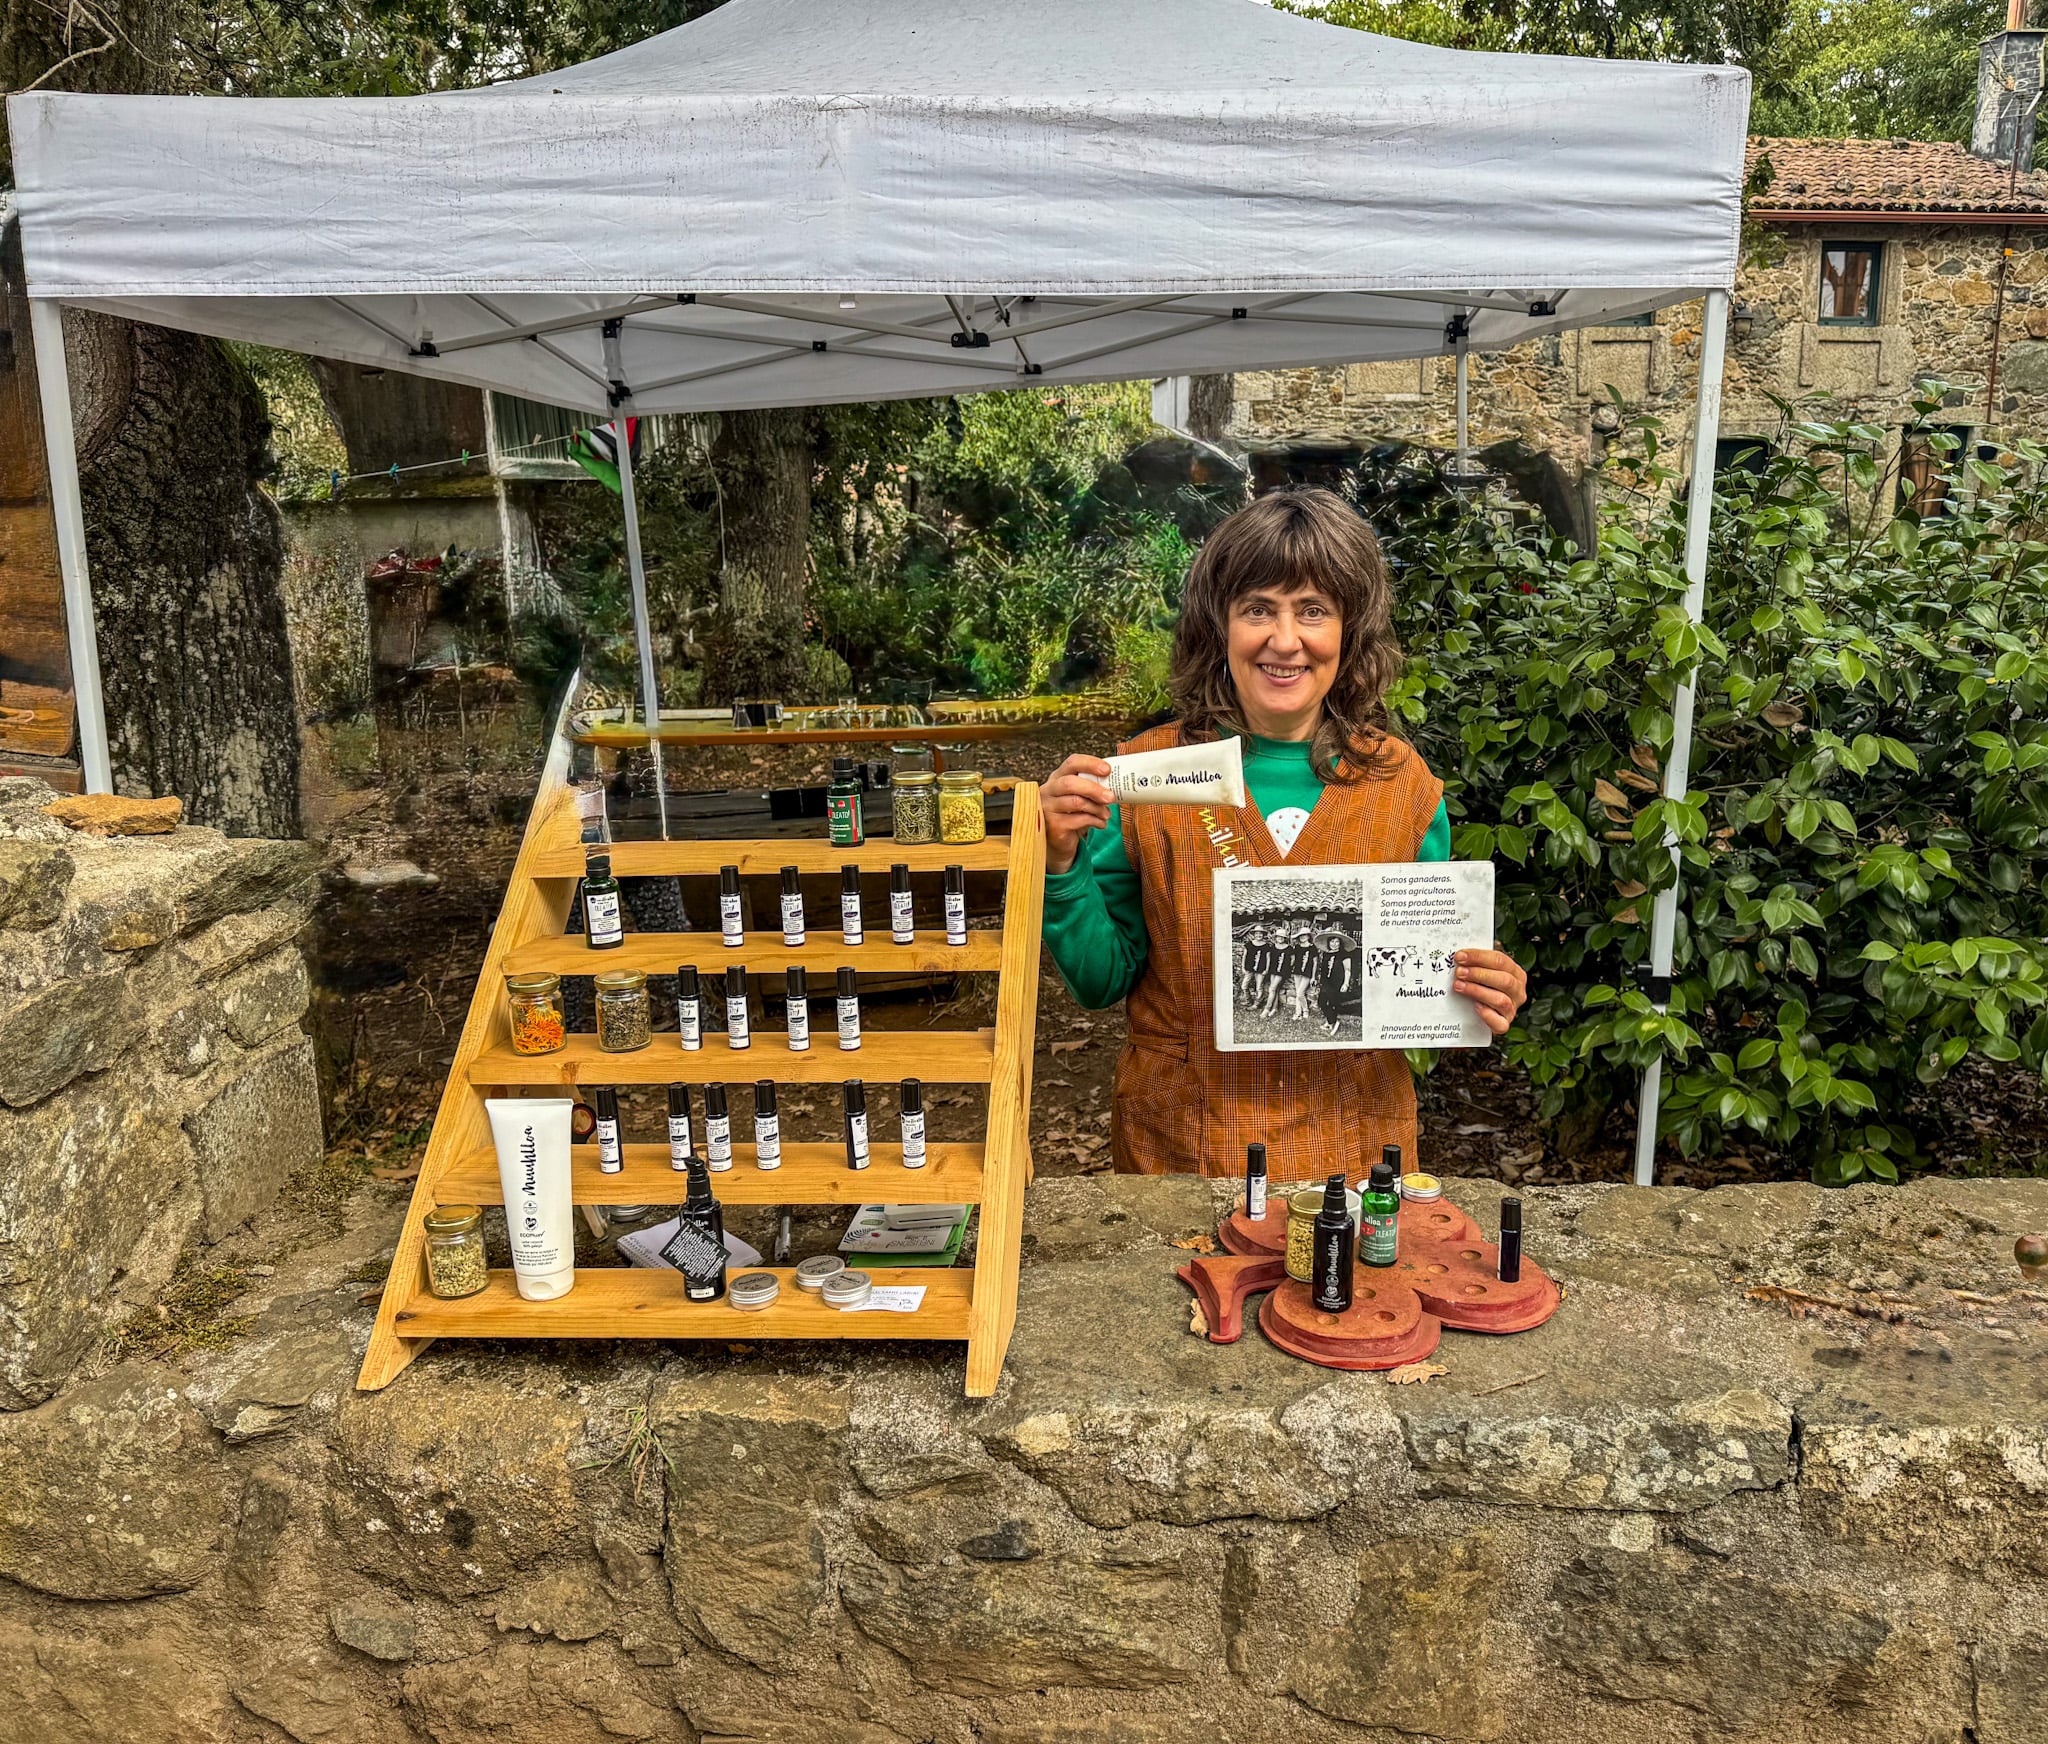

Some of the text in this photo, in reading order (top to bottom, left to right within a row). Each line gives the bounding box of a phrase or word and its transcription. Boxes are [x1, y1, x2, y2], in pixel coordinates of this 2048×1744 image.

[1165, 770, 1223, 785] Muuhlloa
[1381, 875, 1452, 885] Somos ganaderas.
[1381, 887, 1457, 896] Somos agricultoras.
[1381, 898, 1456, 910] Somos productoras
[1380, 908, 1456, 919] de la materia prima
[1380, 917, 1463, 927] de nuestra cosmética.
[1395, 986, 1447, 998] Muuhlloa
[1381, 1024, 1421, 1032] Innovando
[1441, 1023, 1461, 1032] rural,
[1380, 1032, 1387, 1040] el
[1388, 1032, 1406, 1040] rural
[1416, 1031, 1461, 1040] vanguardia.
[520, 1125, 537, 1196] Muuhlloa
